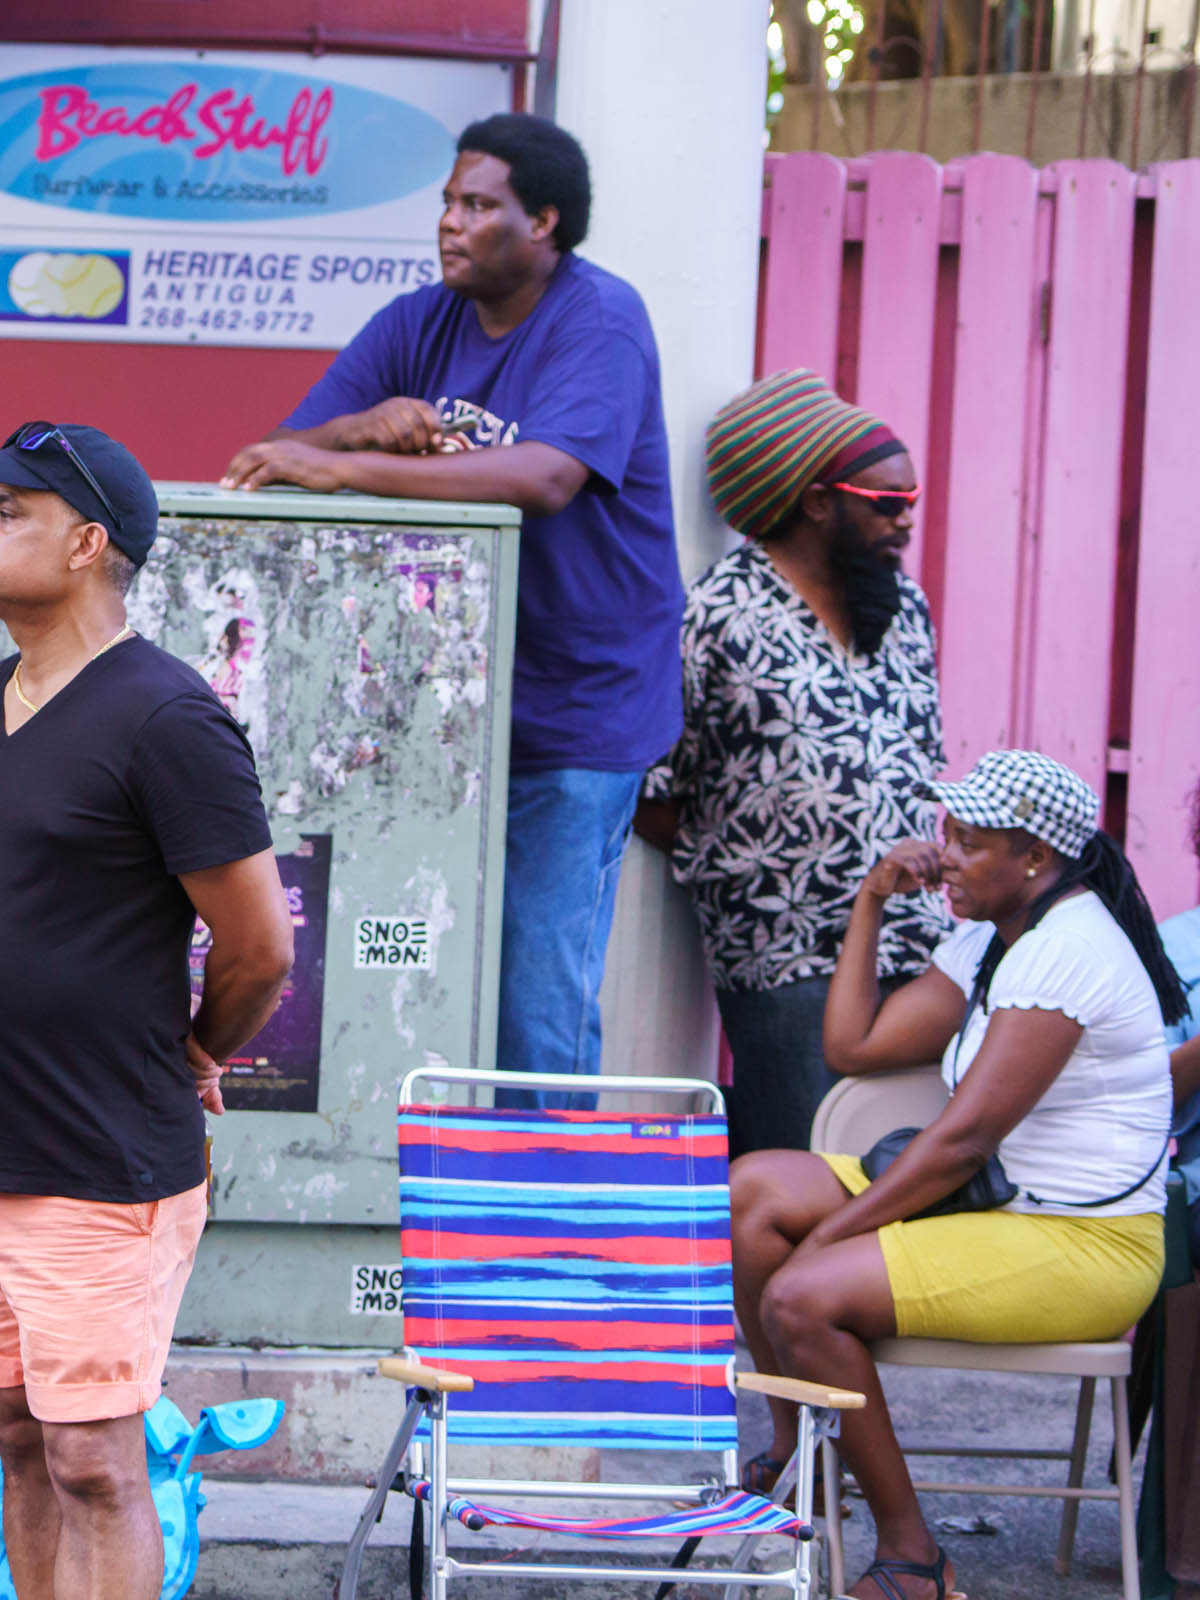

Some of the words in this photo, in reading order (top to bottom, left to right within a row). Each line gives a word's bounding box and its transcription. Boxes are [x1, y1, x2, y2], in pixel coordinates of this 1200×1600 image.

[35, 83, 197, 162] Beach
[194, 87, 333, 177] Stuff
[177, 179, 328, 205] Accessories
[142, 249, 302, 283] HERITAGE
[308, 255, 437, 286] SPORTS
[140, 281, 298, 306] ANTIGUA
[140, 305, 315, 333] 268-462-9772
[356, 1266, 403, 1290] SNO
